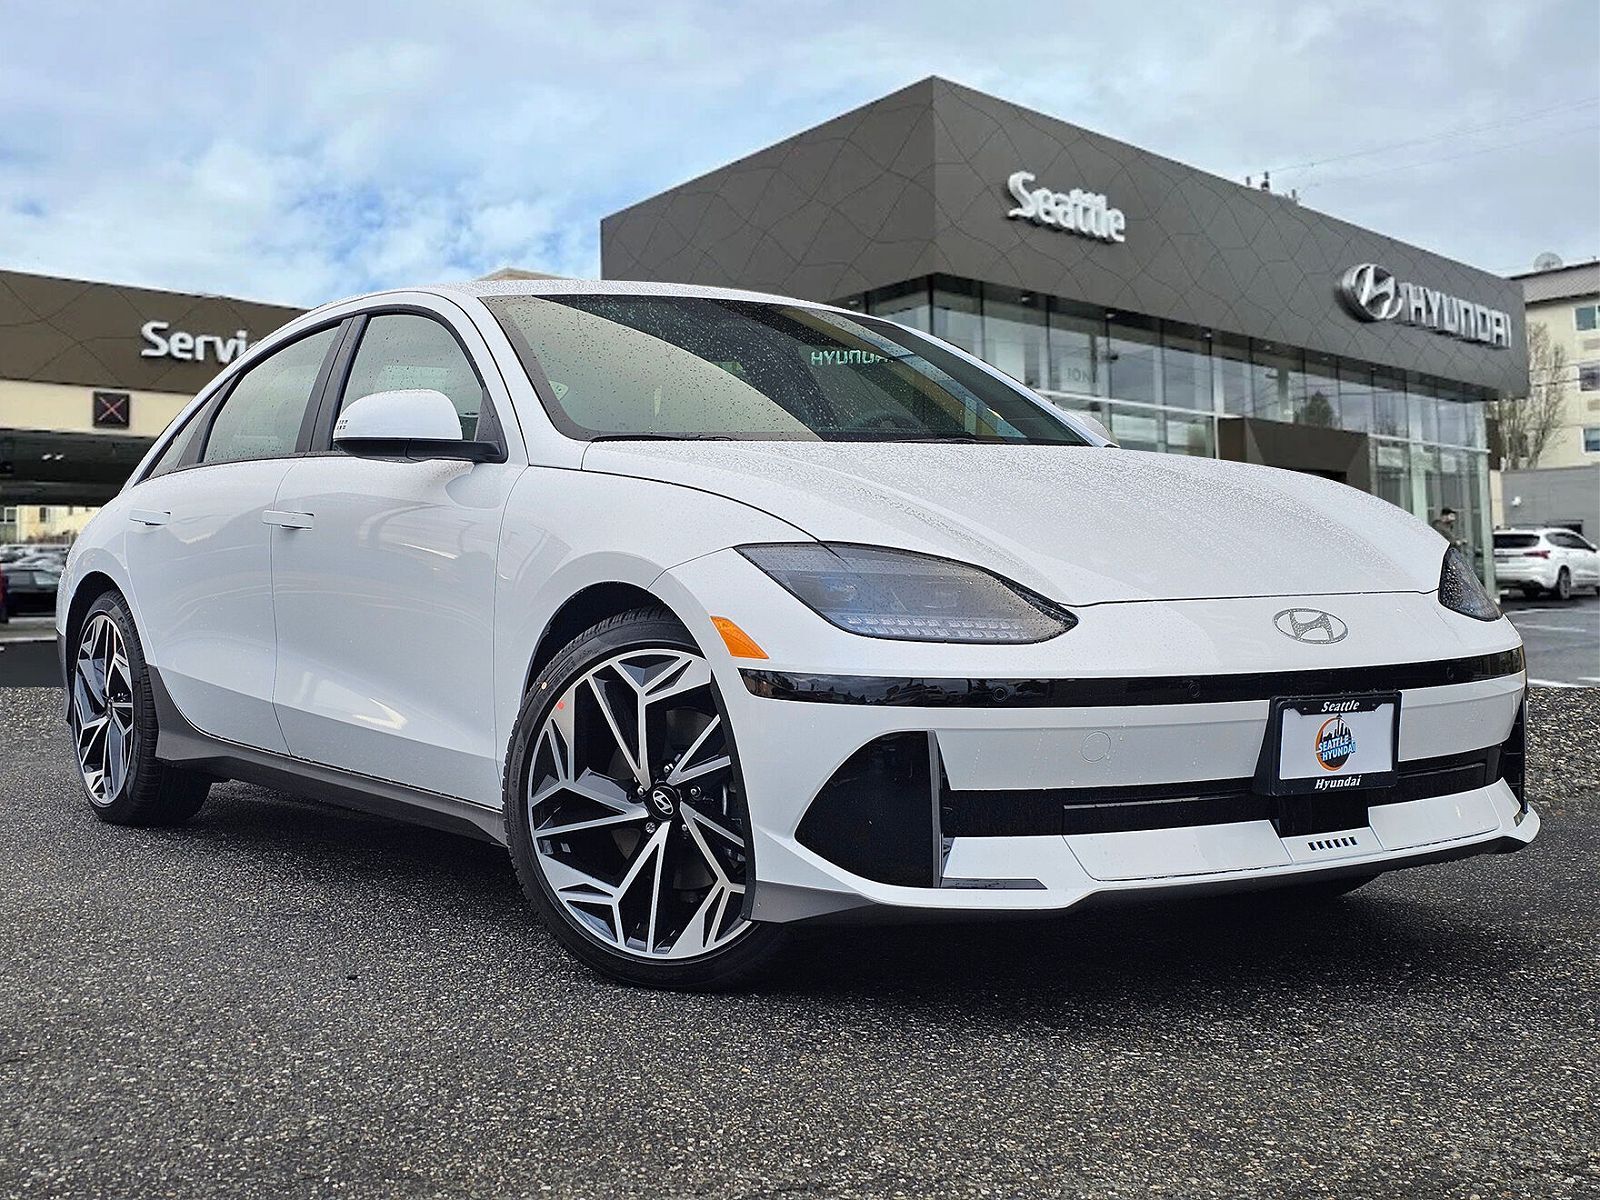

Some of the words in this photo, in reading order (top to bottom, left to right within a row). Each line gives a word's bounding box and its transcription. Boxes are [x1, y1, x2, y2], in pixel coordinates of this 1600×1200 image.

[1007, 170, 1125, 243] Seattle
[1401, 283, 1512, 348] HYUNDAI
[141, 320, 257, 363] Servi
[1320, 699, 1361, 713] Seattle
[1318, 734, 1350, 752] SEATTLE
[1314, 774, 1362, 791] Hyundai
